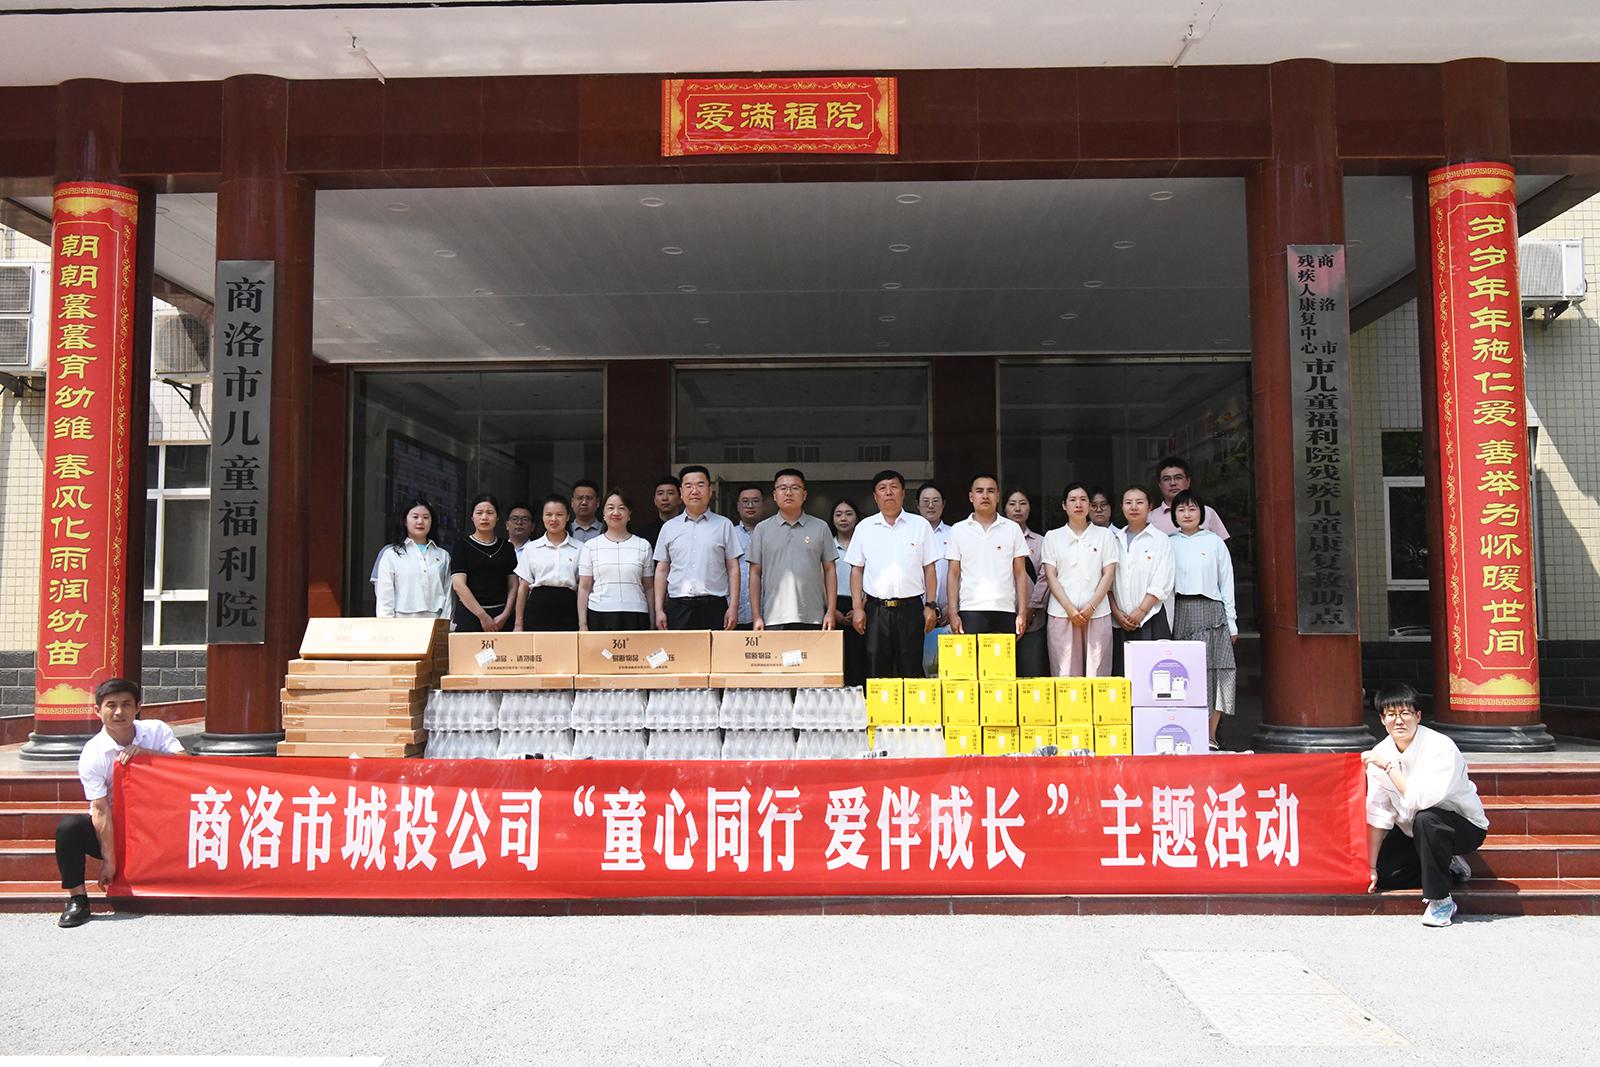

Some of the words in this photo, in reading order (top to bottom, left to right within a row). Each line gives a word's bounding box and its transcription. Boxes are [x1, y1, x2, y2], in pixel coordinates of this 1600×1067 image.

[696, 101, 864, 132] 爱满福院
[53, 232, 100, 440] 朝朝暮暮育幼雏
[1297, 254, 1318, 354] 残疾人康复中心
[1317, 254, 1339, 355] 商洛市
[1467, 214, 1517, 427] 岁岁年年施仁爱
[216, 276, 265, 628] 商洛市儿童福利院
[1475, 439, 1526, 657] 善举为怀暖世间
[46, 453, 95, 667] 春风化雨润幼苗
[189, 786, 541, 871] 商洛市城投公司
[1100, 783, 1300, 868] 主题活动
